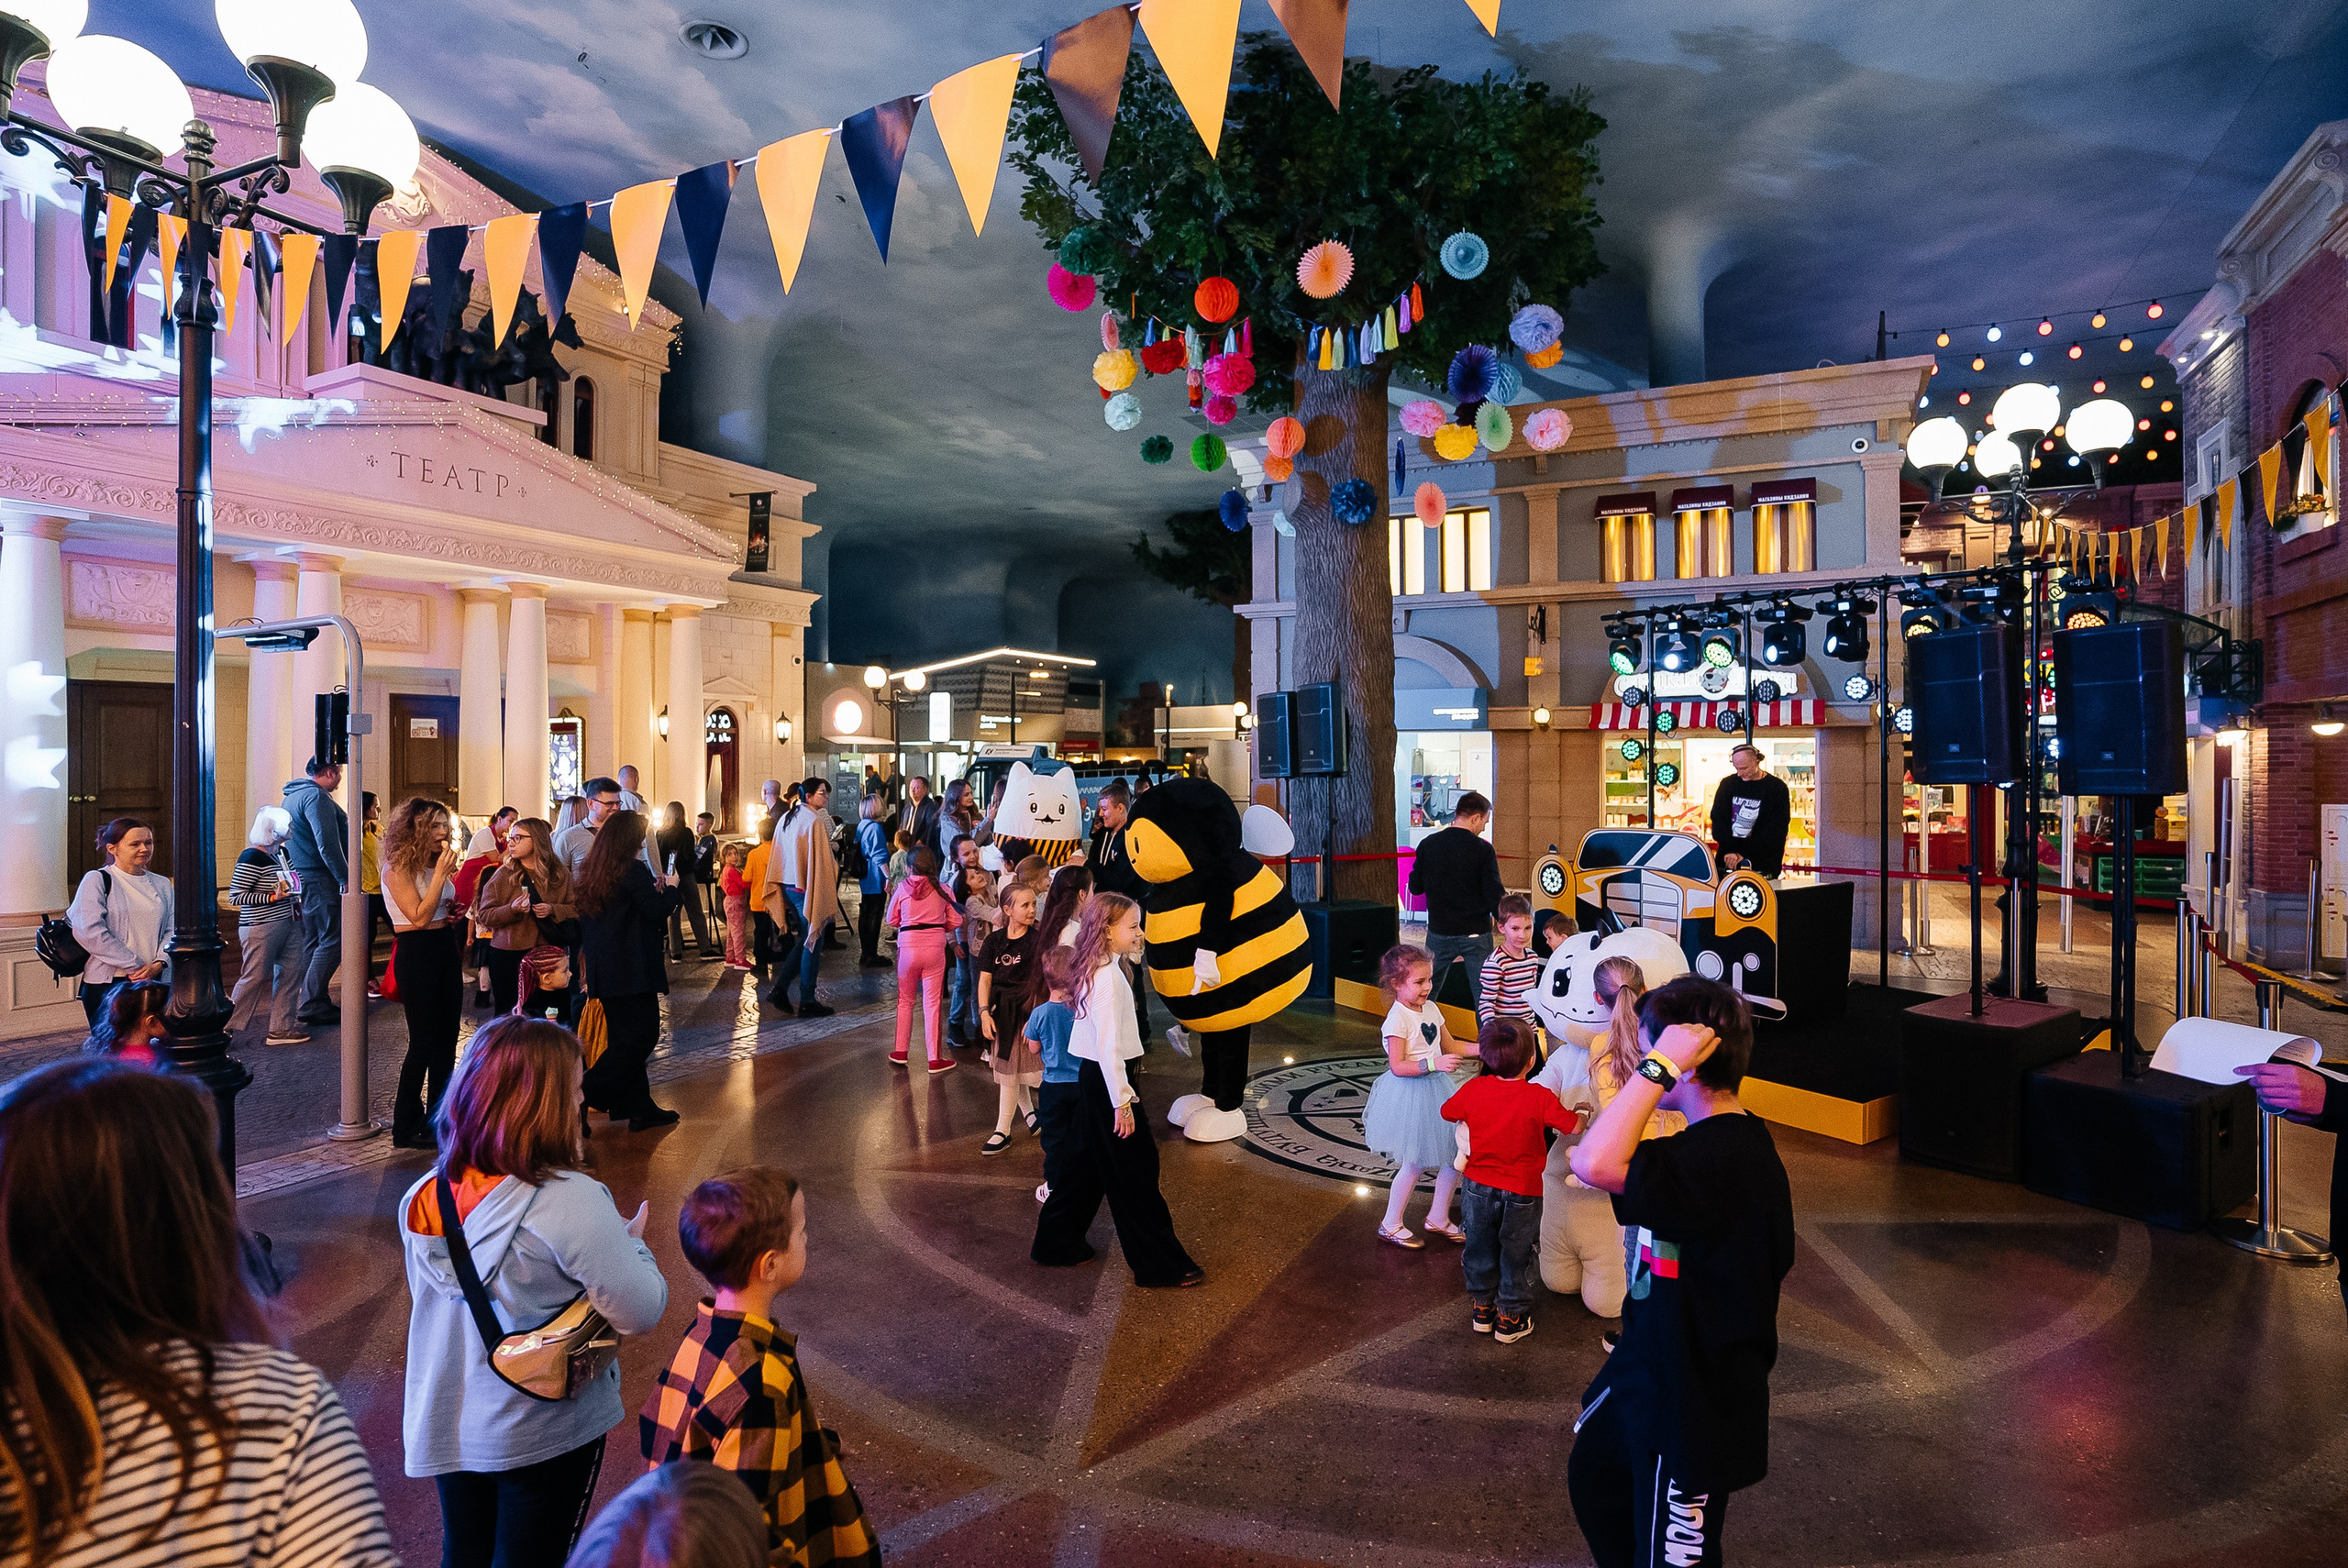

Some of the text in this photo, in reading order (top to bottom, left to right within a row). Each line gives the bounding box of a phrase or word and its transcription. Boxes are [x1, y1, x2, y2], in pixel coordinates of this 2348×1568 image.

[391, 451, 509, 497] ТЕАТР
[1084, 806, 1098, 822] Эт
[1302, 1060, 1389, 1074] РУКАМ
